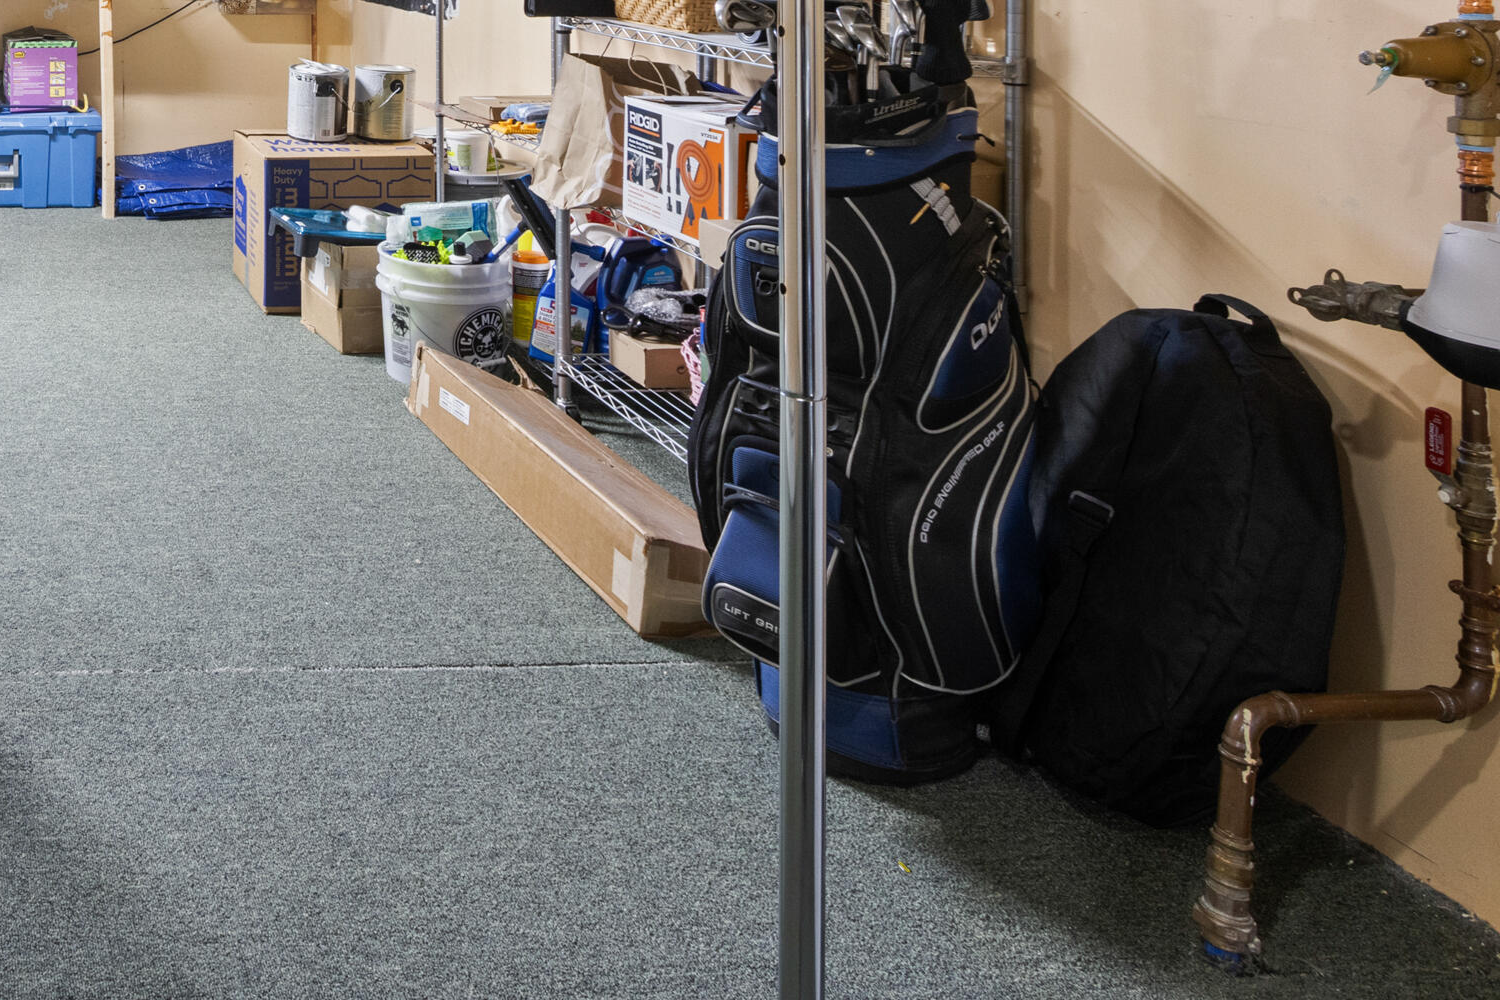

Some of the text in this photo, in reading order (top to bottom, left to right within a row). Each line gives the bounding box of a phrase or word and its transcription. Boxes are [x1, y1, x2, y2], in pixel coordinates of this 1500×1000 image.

[629, 110, 659, 132] RIDGID
[273, 167, 303, 177] Heavy
[273, 176, 296, 185] Duty
[920, 508, 938, 543] OGIO
[983, 421, 1005, 447] GOLF
[724, 602, 778, 634] LIFT GRI
